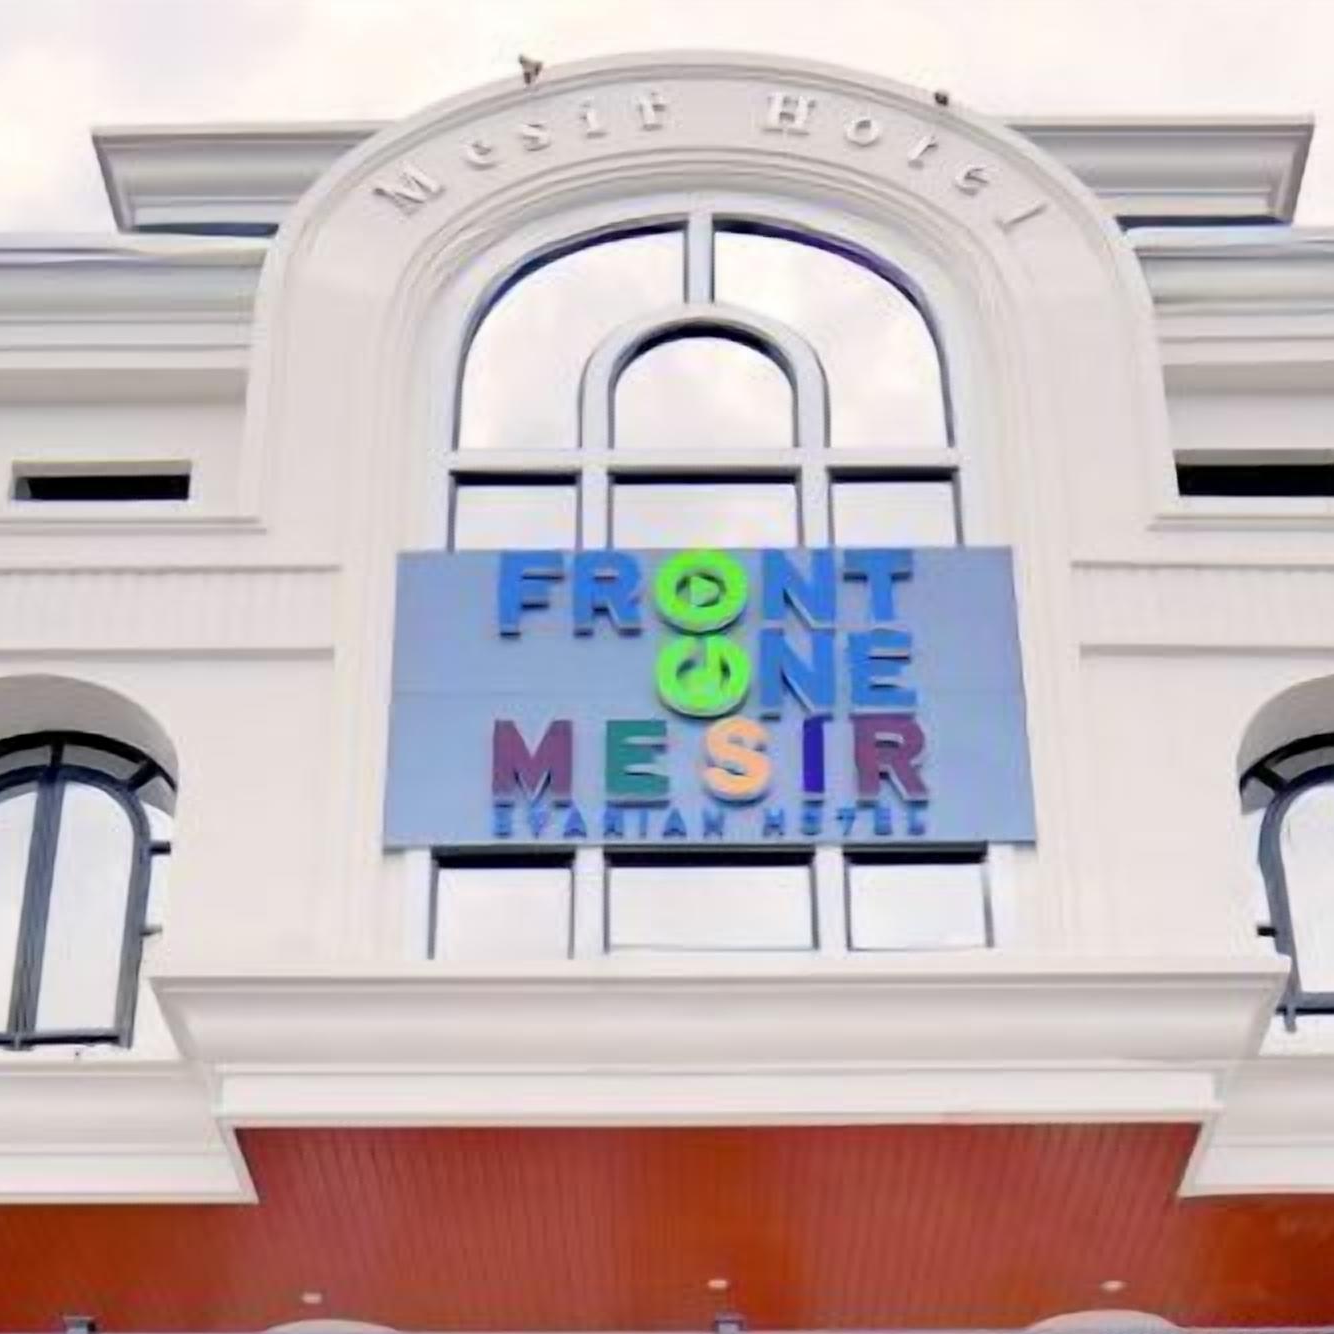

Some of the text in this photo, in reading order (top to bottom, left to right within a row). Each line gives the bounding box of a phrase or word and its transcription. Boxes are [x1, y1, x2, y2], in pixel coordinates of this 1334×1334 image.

[497, 549, 914, 636] FRONT
[654, 630, 917, 719] ONE
[491, 715, 930, 805] MESIR
